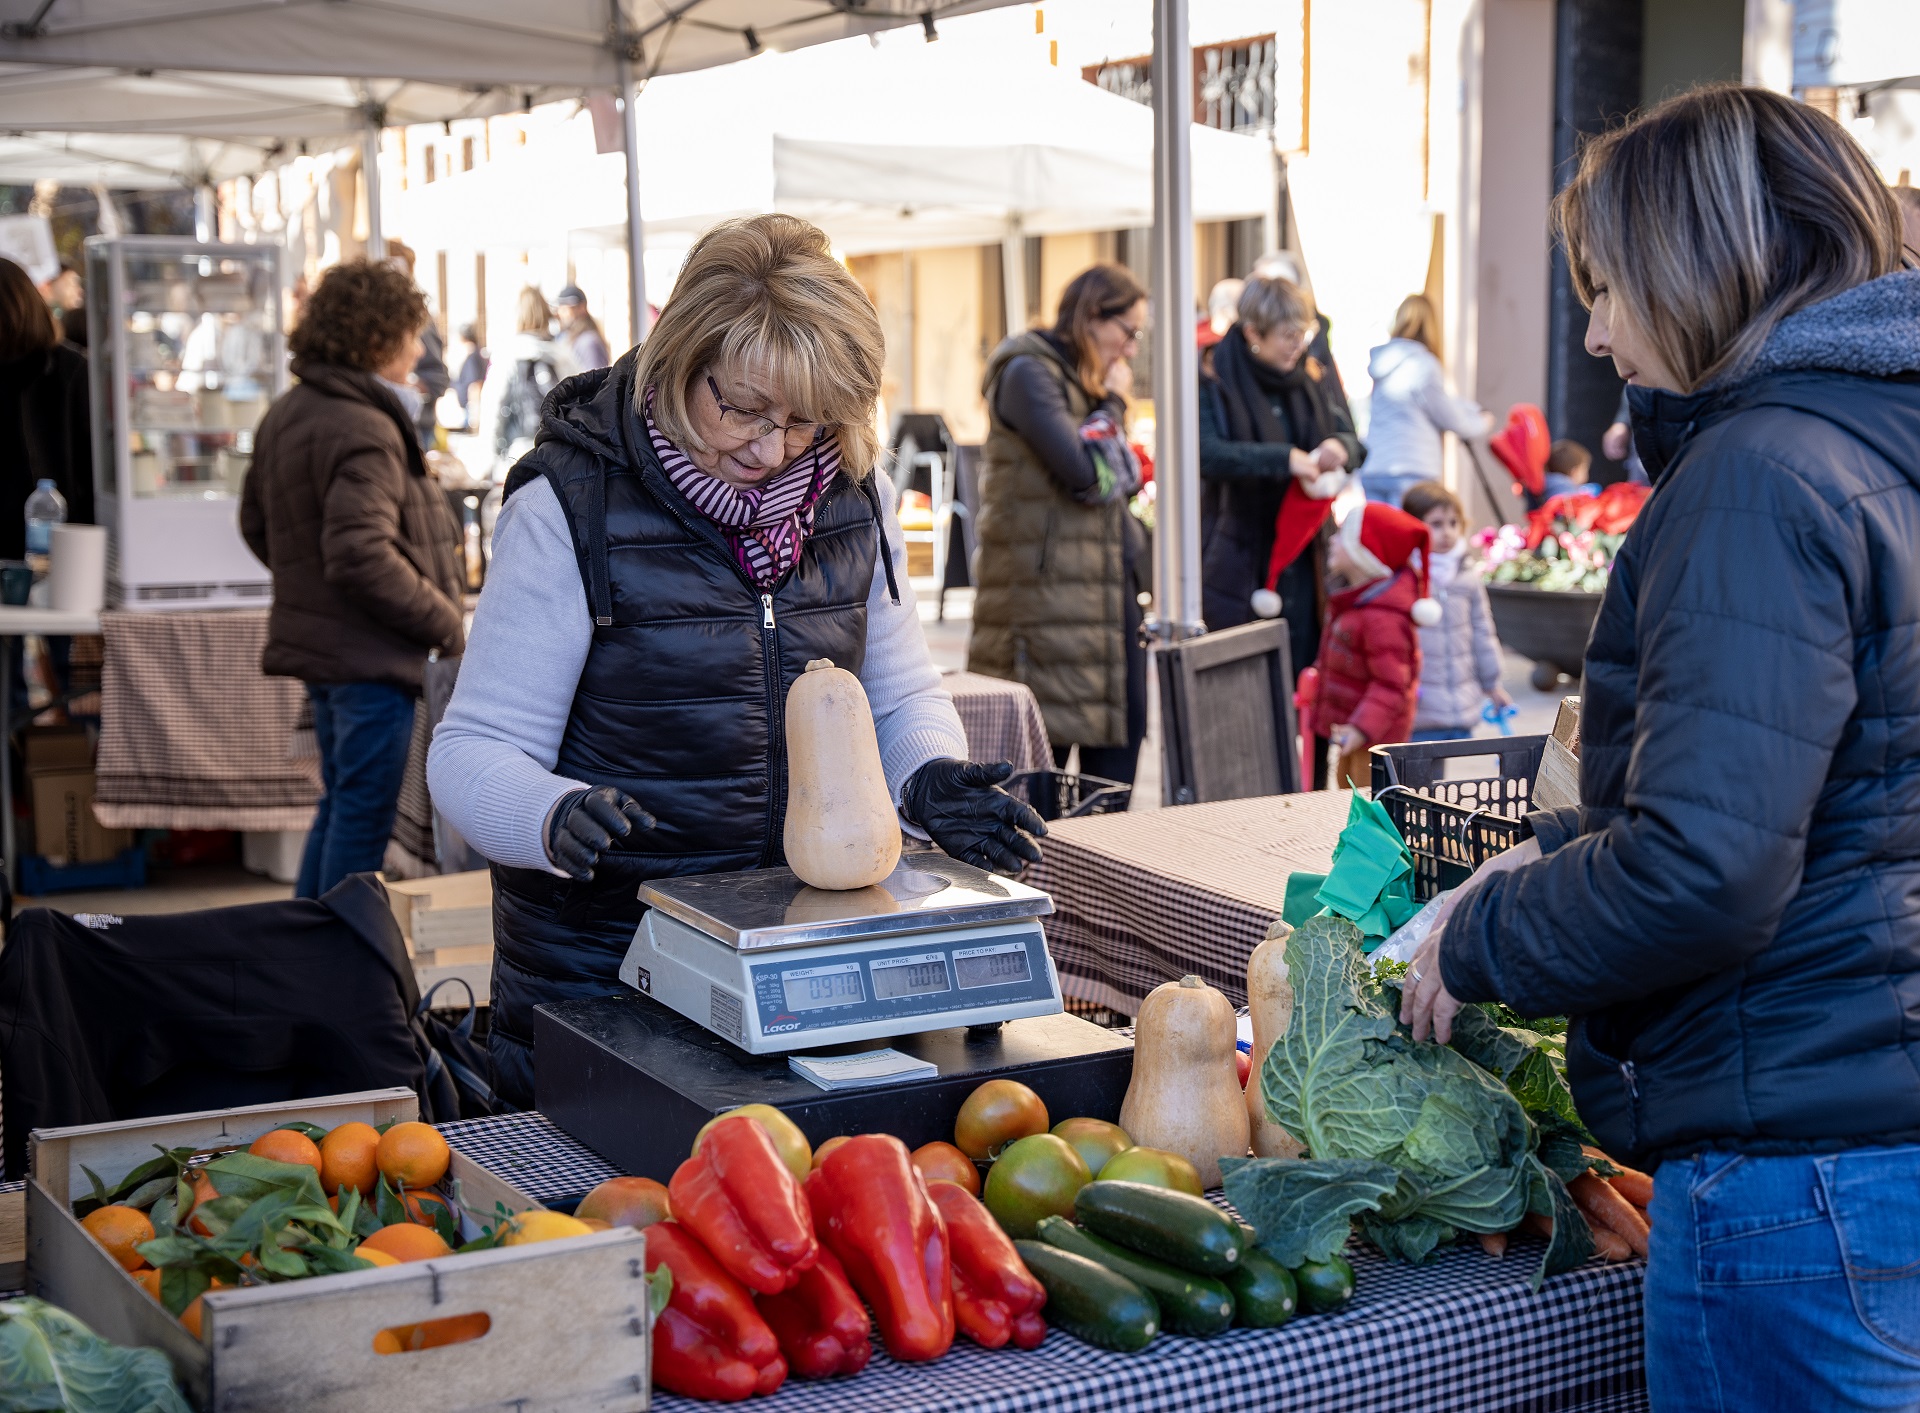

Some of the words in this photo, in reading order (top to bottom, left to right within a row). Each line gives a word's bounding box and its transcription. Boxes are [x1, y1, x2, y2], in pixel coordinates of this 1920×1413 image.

[90, 920, 109, 930] THE
[891, 957, 911, 965] PRICE:
[755, 973, 778, 982] KSP-30
[789, 969, 815, 977] WEIGHT:
[908, 963, 943, 988] 0.00
[810, 974, 858, 1000] 0.970
[763, 1022, 801, 1034] Lacor
